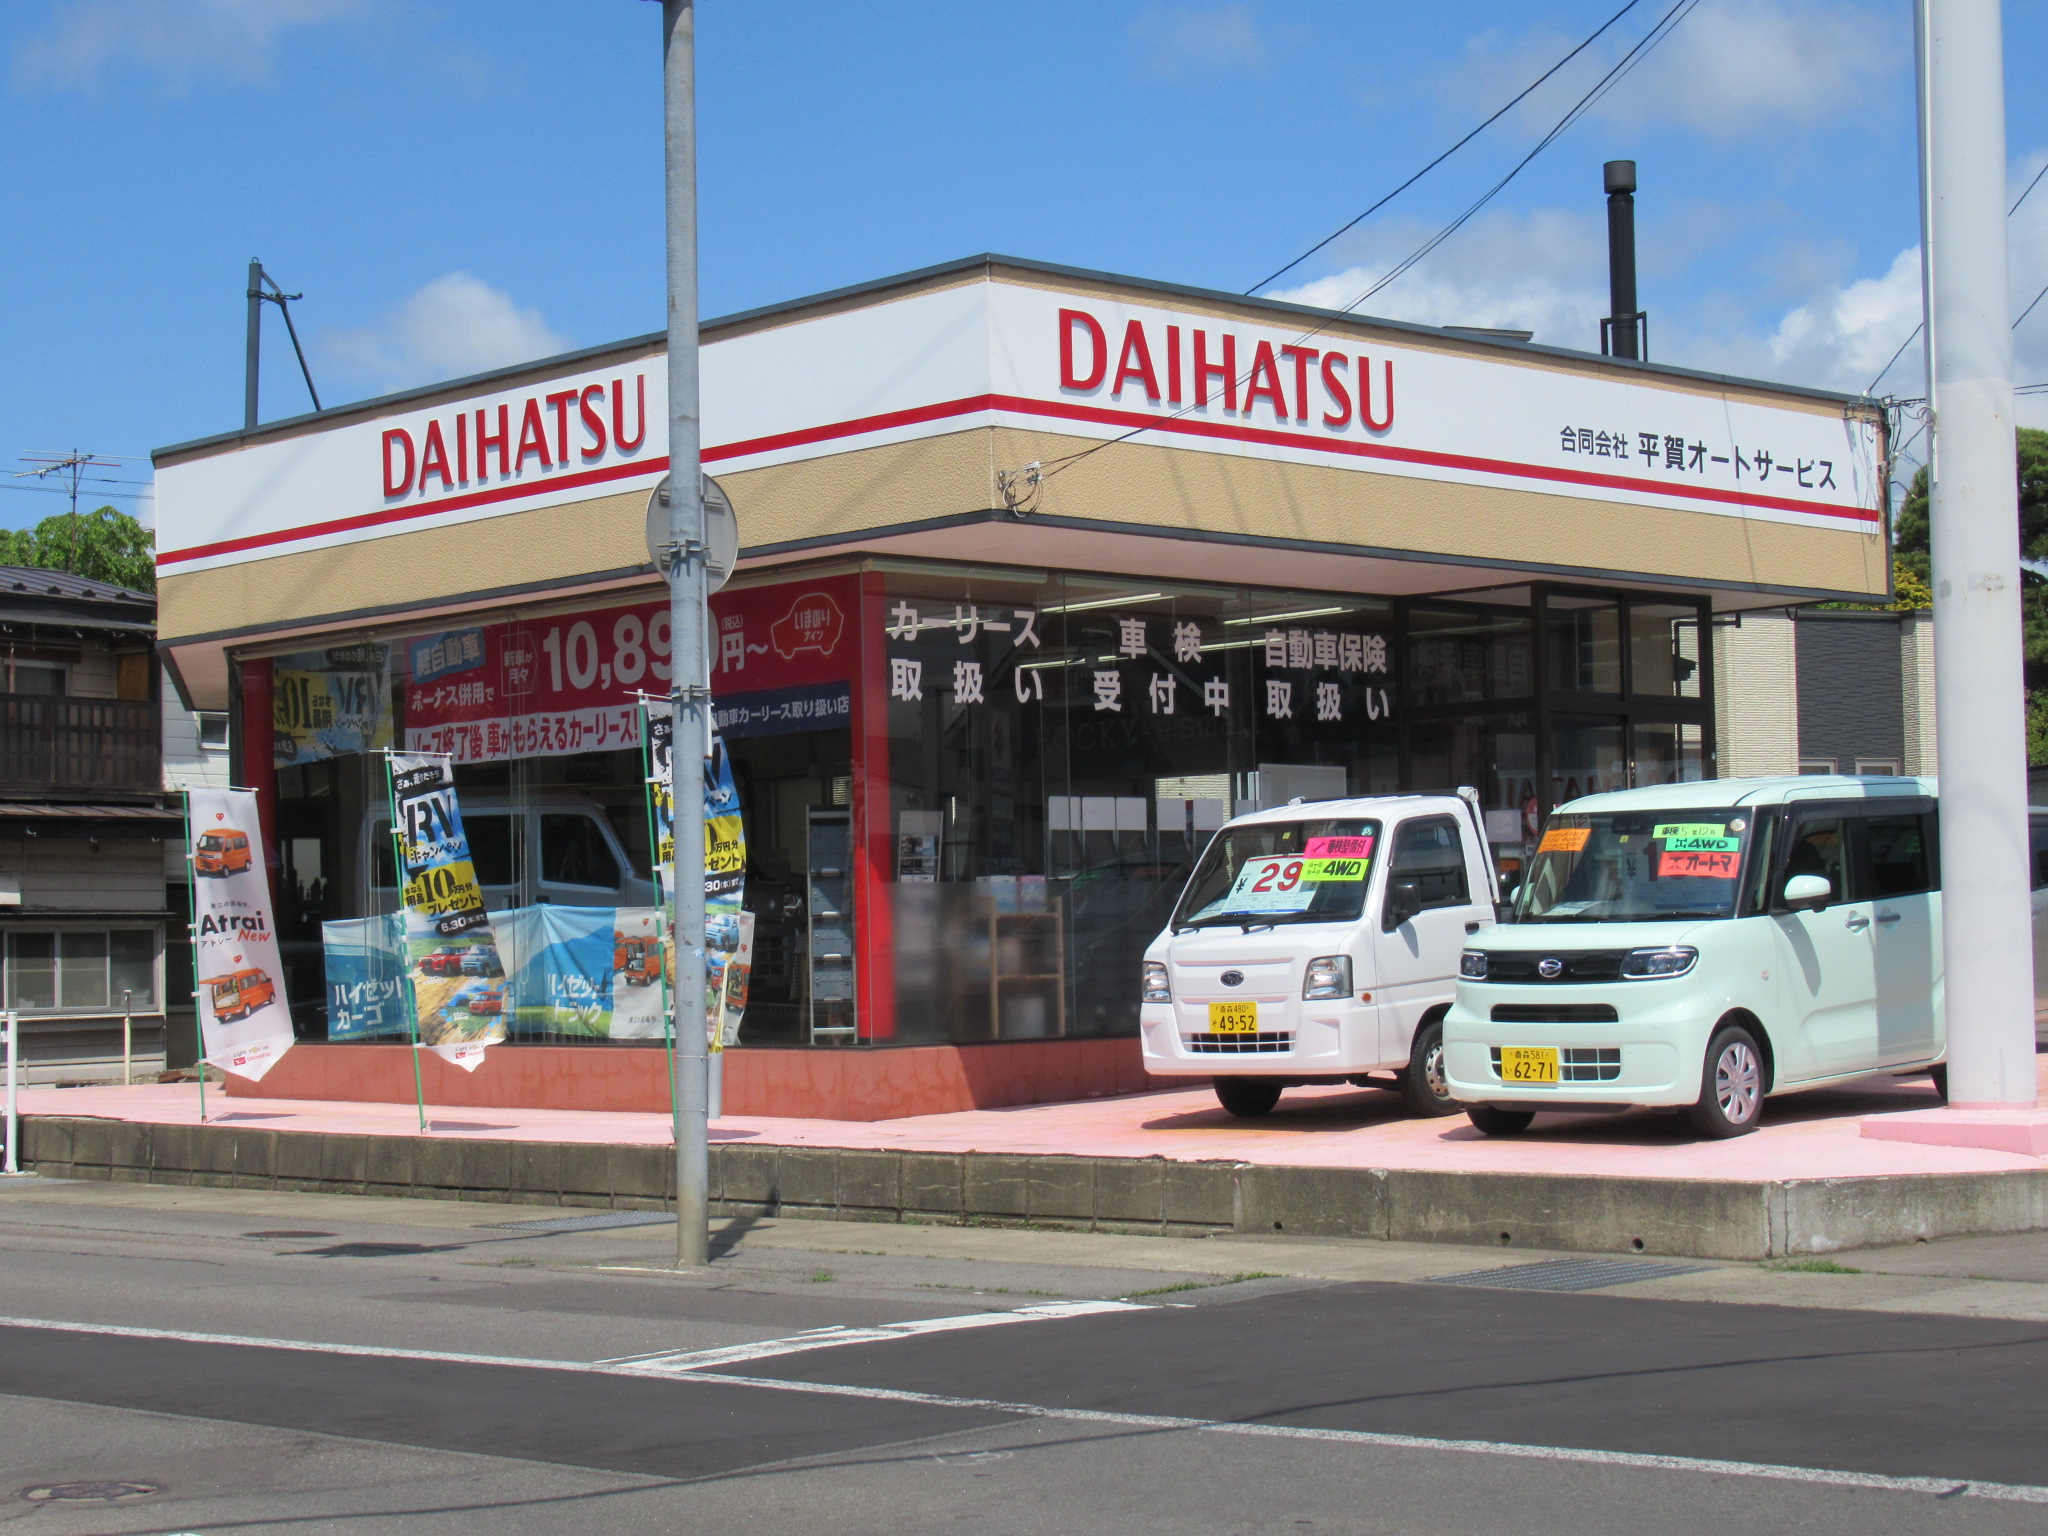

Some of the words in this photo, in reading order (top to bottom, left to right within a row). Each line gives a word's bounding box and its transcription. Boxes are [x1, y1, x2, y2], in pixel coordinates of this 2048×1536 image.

[1059, 308, 1394, 432] DAIHATSU
[382, 374, 646, 498] DAIHATSU
[1560, 425, 1629, 459] 合同会社
[1638, 432, 1837, 490] 平賀オートサービス
[891, 601, 1041, 649] カーリース
[1119, 618, 1202, 663] 車検
[415, 633, 482, 676] 軽自動車
[1265, 629, 1387, 674] 自動車保険
[891, 658, 1043, 704] 取扱い
[1093, 670, 1230, 717] 受付中
[1266, 680, 1390, 721] 取扱い
[407, 795, 454, 848] RV
[1688, 838, 1729, 849] 4WD
[1323, 861, 1362, 876] 4WD
[1685, 856, 1733, 873] オートマ
[201, 911, 265, 936] Atrai
[201, 938, 232, 948] アトレー
[237, 928, 271, 942] New
[337, 1002, 384, 1031] カーゴ
[1220, 1015, 1255, 1031] 49-52
[247, 1052, 272, 1061] DAIHATSU
[1514, 1062, 1553, 1079] 62-71
